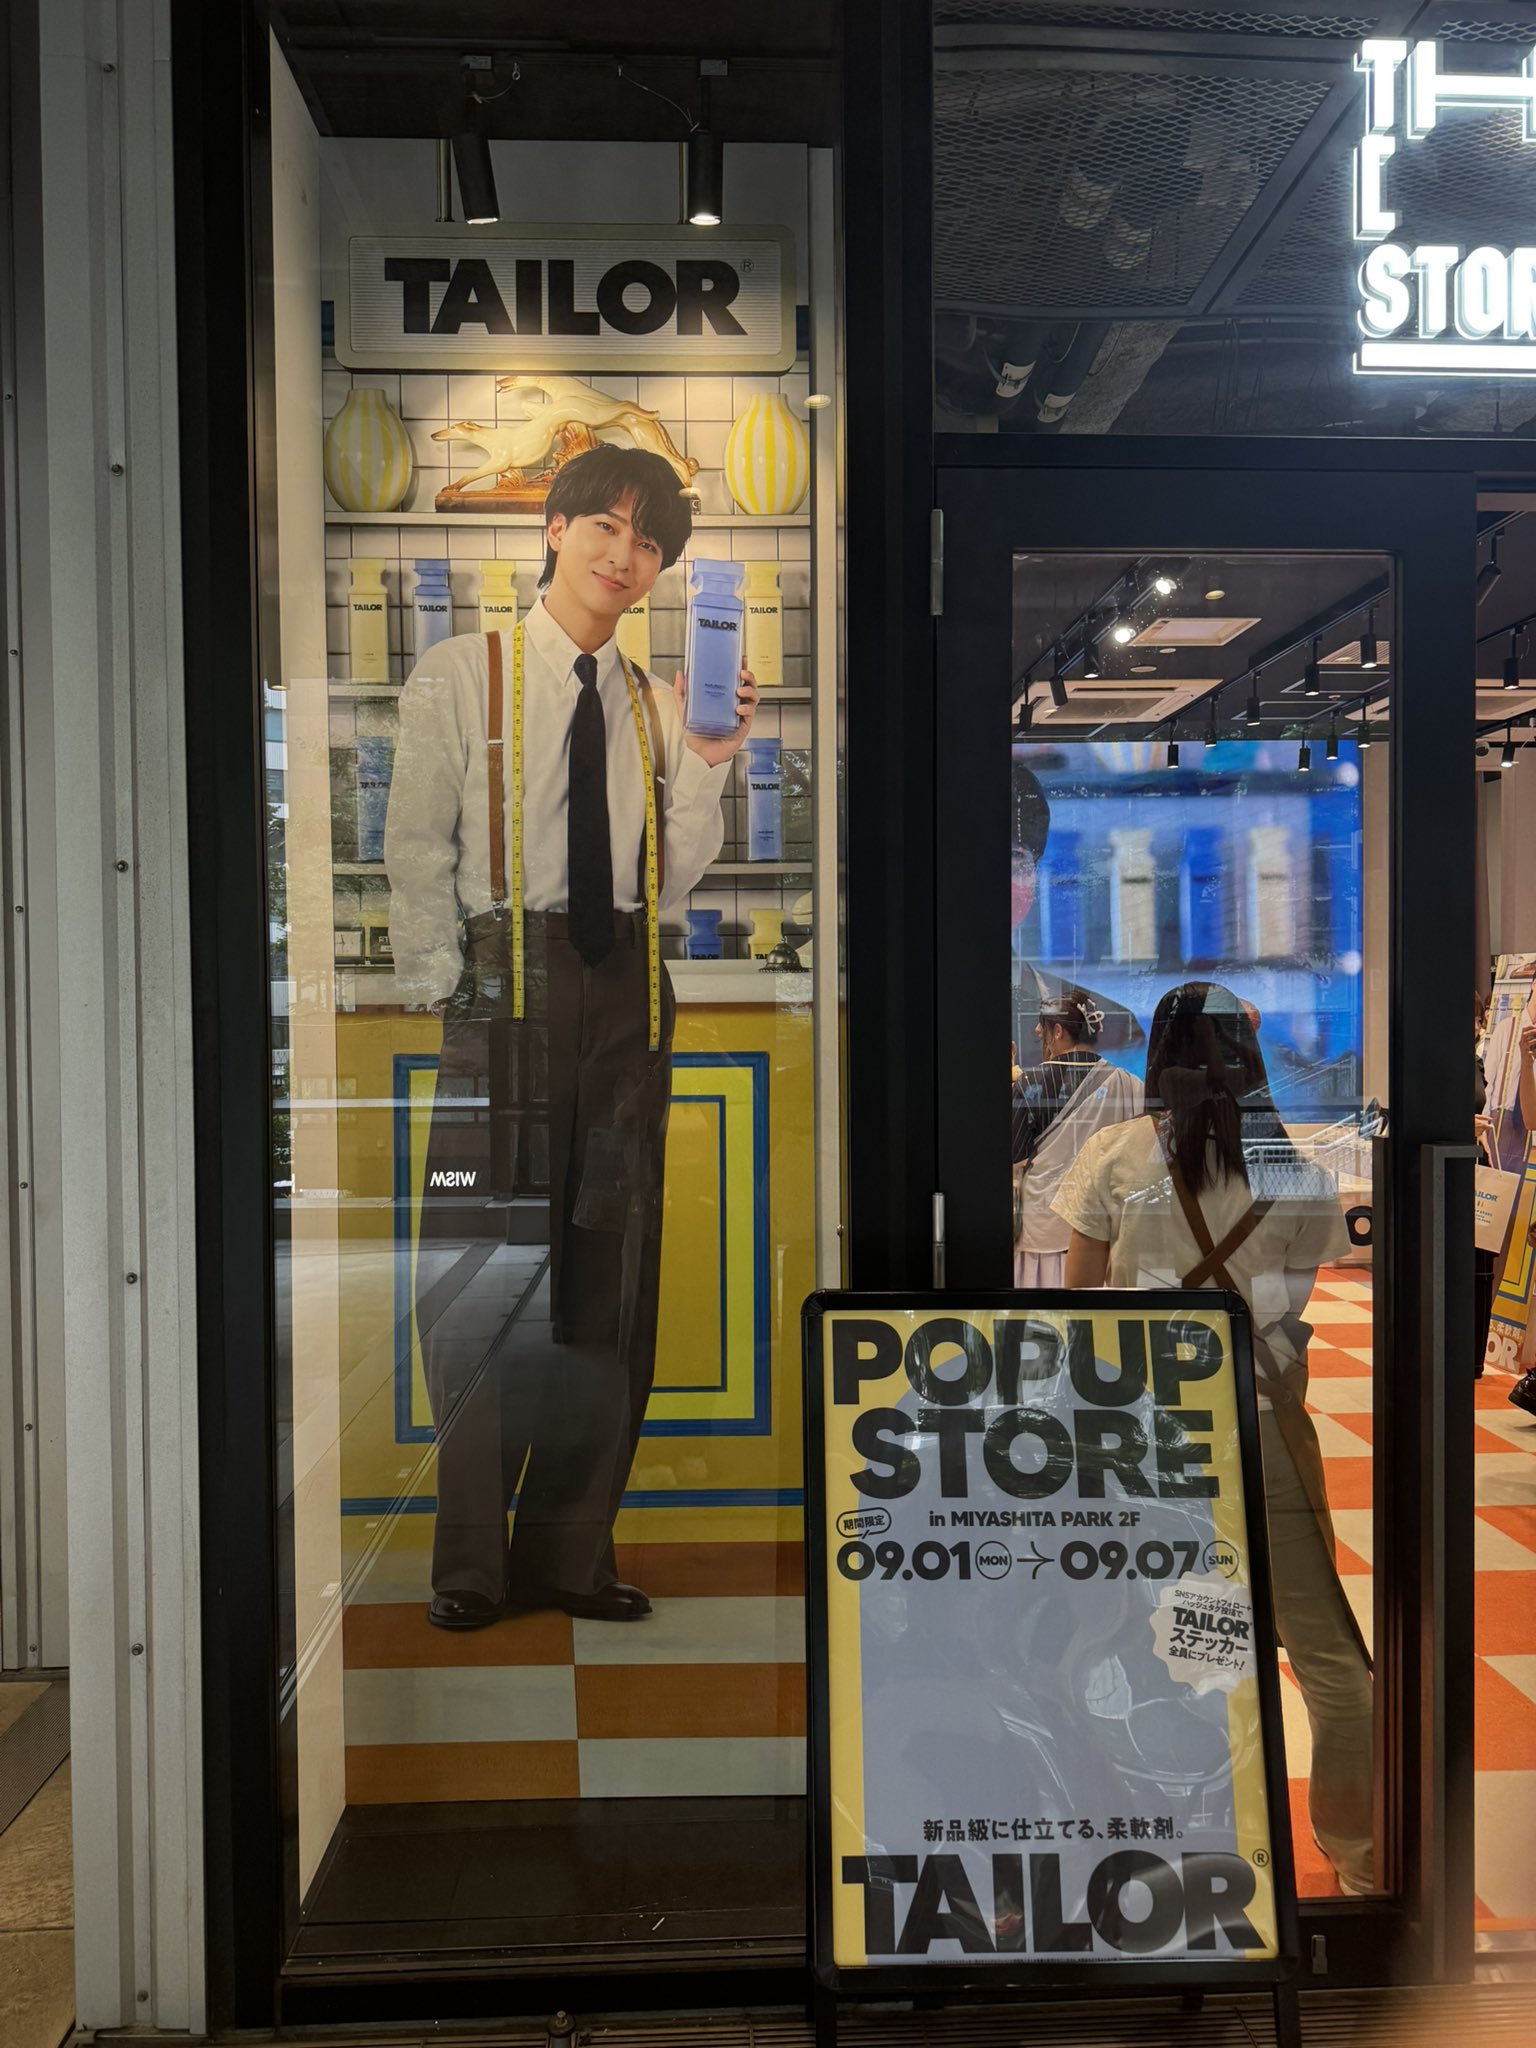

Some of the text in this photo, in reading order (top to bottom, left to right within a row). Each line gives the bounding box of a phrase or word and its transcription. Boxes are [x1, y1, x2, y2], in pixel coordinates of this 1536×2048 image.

[418, 604, 448, 612] TAILOR
[697, 618, 737, 631] TAILOR
[832, 1318, 1223, 1407] POPUP
[849, 1407, 1220, 1500] STORE
[843, 1515, 885, 1531] 期間限定
[929, 1511, 1141, 1527] in MIYASHITA PARK 2F
[836, 1540, 1233, 1581] 09.01 MON 09.07 SUN
[1169, 1627, 1248, 1655] ステッカー
